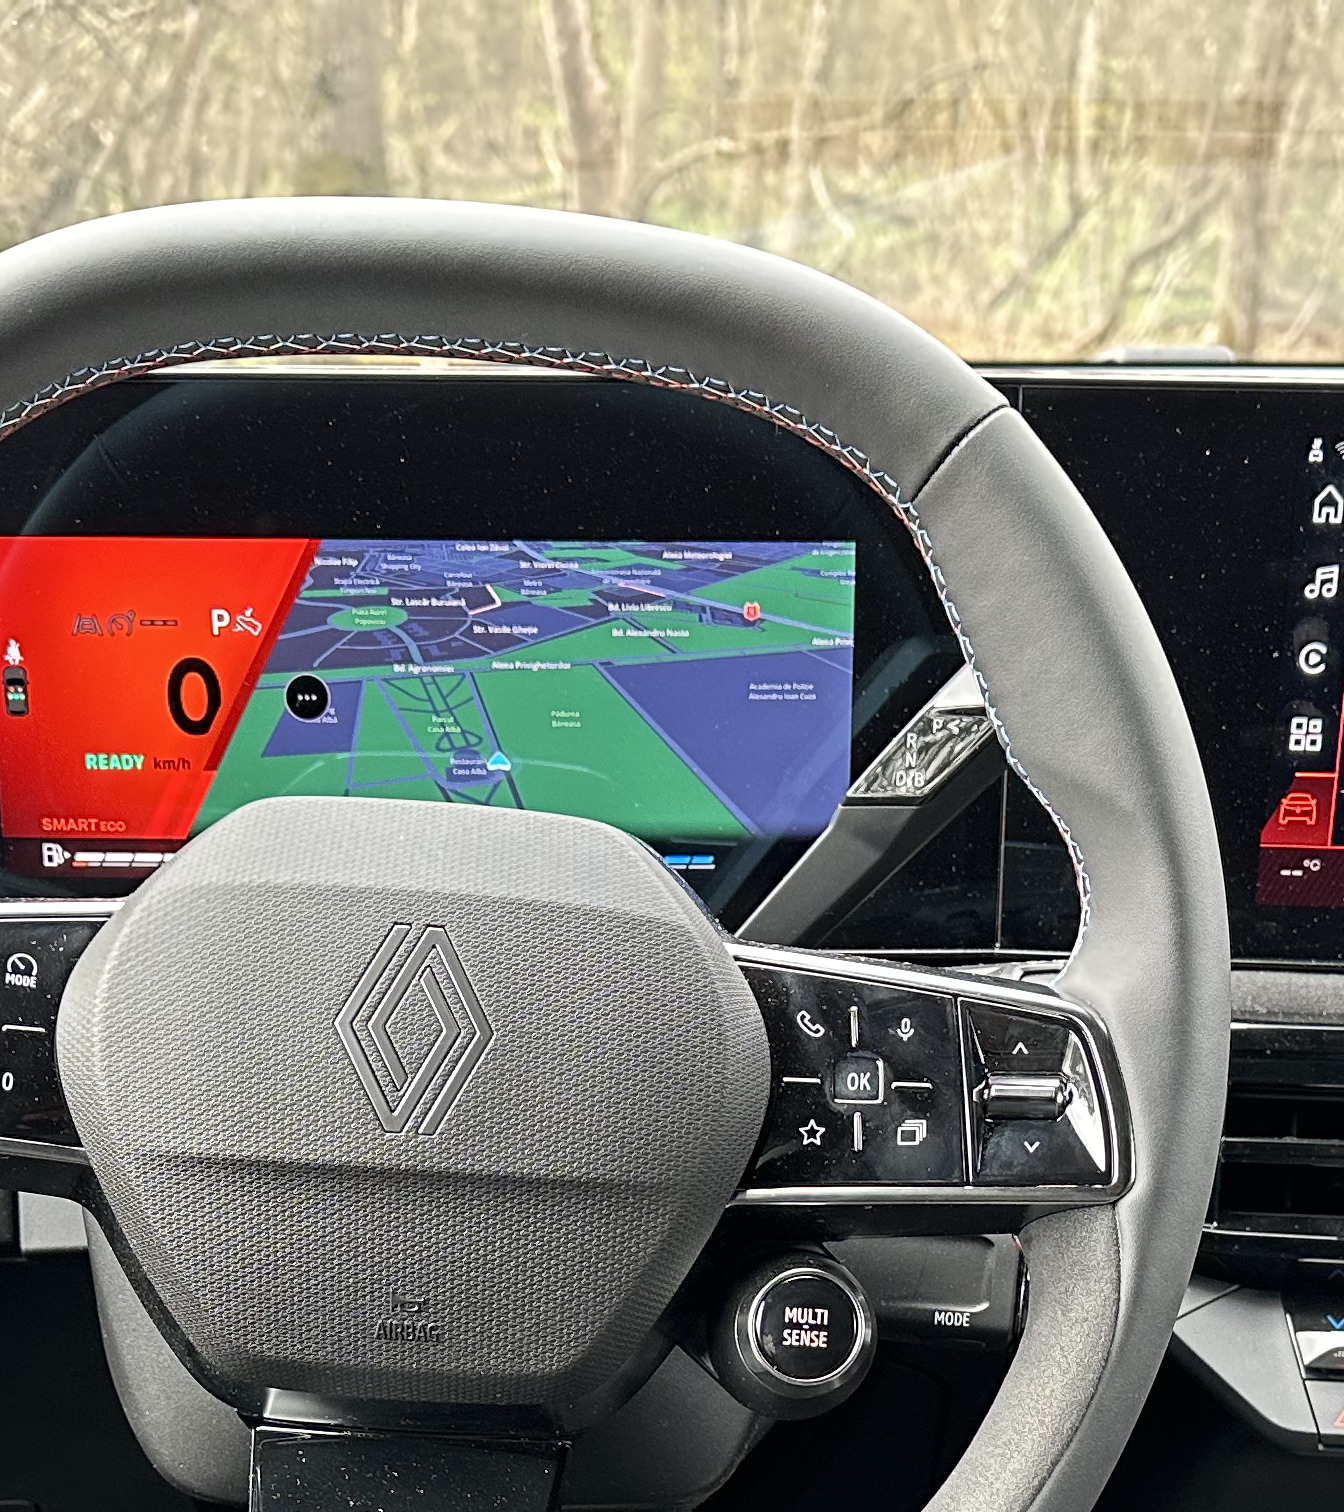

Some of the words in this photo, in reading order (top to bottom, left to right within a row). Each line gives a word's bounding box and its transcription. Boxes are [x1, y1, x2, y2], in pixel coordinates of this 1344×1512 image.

[210, 608, 232, 636] P
[166, 655, 223, 737] 0
[85, 753, 145, 771] READY
[153, 755, 192, 771] km/h
[40, 817, 99, 832] SMART
[99, 819, 127, 833] ECO
[4, 971, 38, 989] MODE
[1, 1070, 15, 1092] 0
[845, 1070, 872, 1092] OK
[783, 1305, 830, 1327] MULTI
[932, 1310, 971, 1328] MODE
[374, 1317, 443, 1343] AIRBAG
[781, 1328, 829, 1349] SENSE
